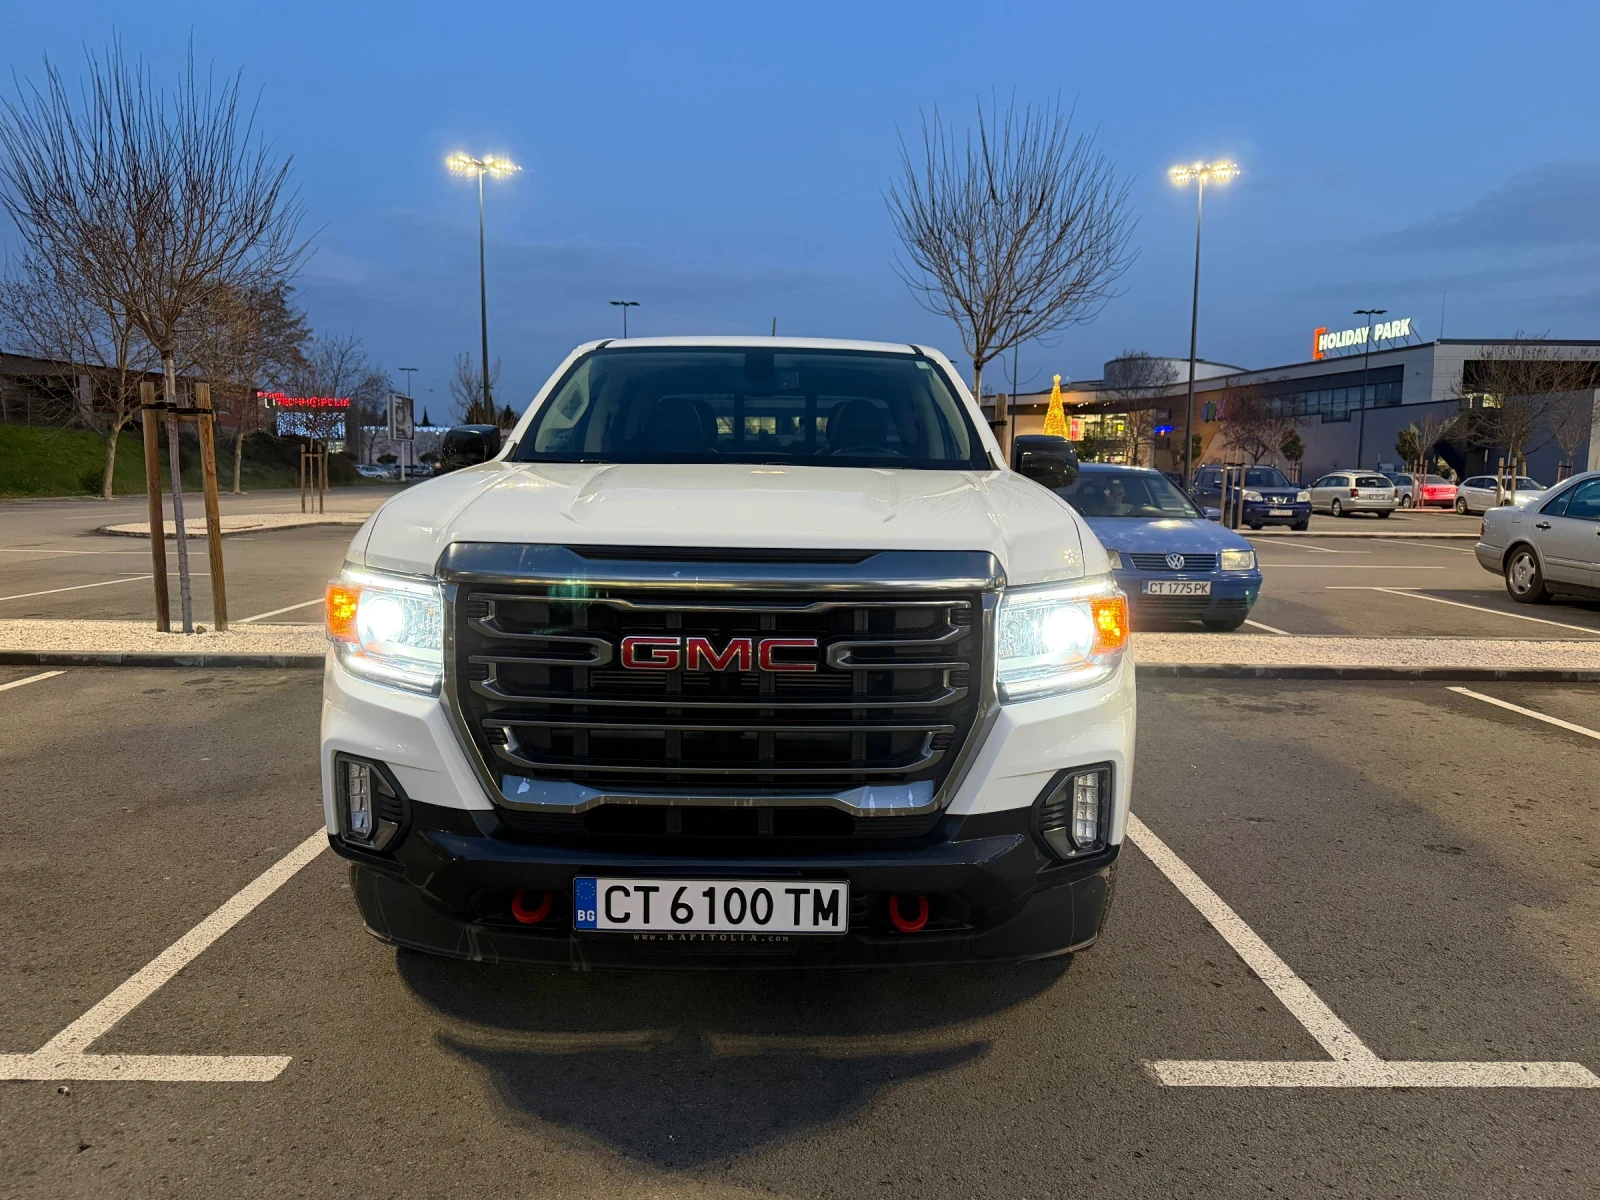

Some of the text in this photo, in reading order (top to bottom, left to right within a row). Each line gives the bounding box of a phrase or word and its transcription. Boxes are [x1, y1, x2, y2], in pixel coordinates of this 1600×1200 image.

[1319, 318, 1411, 350] HOLIDAY PARK
[1150, 582, 1165, 593] CT
[621, 636, 817, 672] GMC
[577, 909, 595, 922] BG
[604, 885, 840, 927] CT 6100 TM
